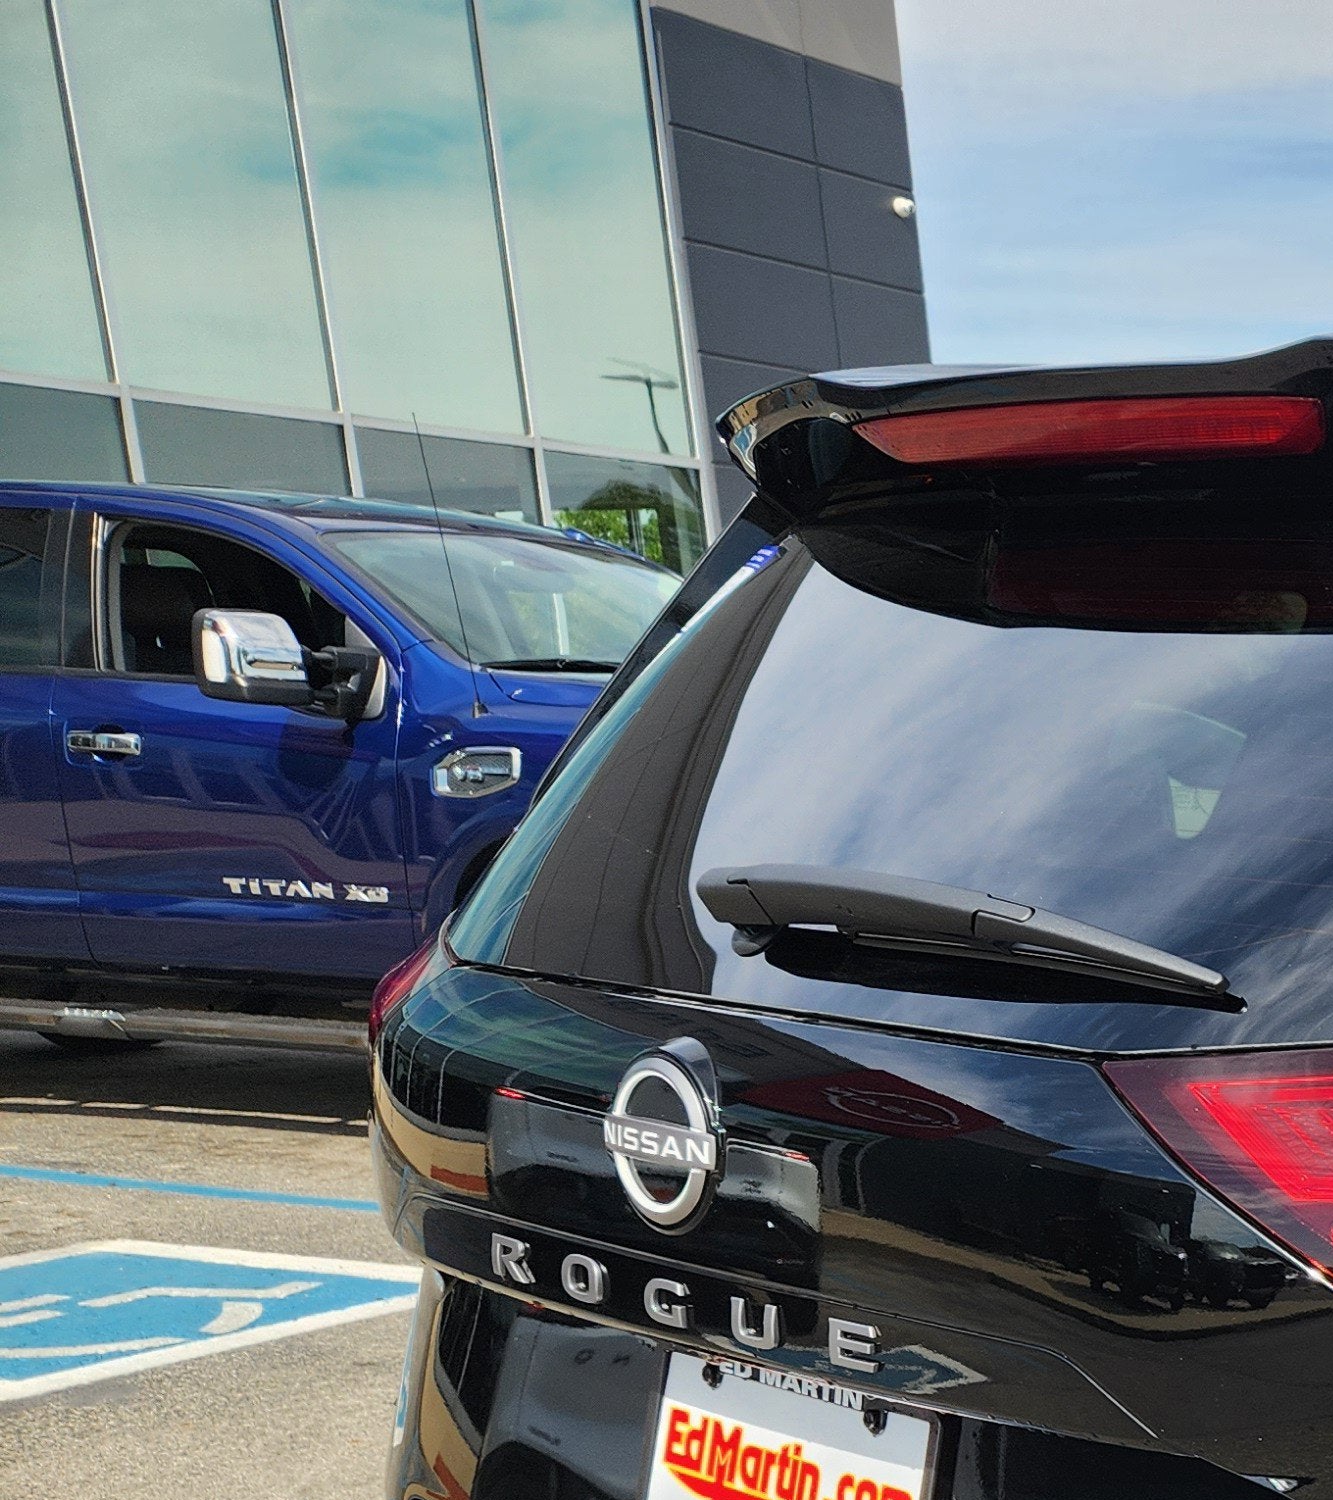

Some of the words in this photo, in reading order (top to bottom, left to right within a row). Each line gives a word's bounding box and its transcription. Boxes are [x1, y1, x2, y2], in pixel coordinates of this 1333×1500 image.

[222, 876, 335, 900] TITAN
[603, 1121, 712, 1166] NISSAN
[491, 1232, 886, 1374] ROGUE
[758, 1367, 864, 1412] MARTIN
